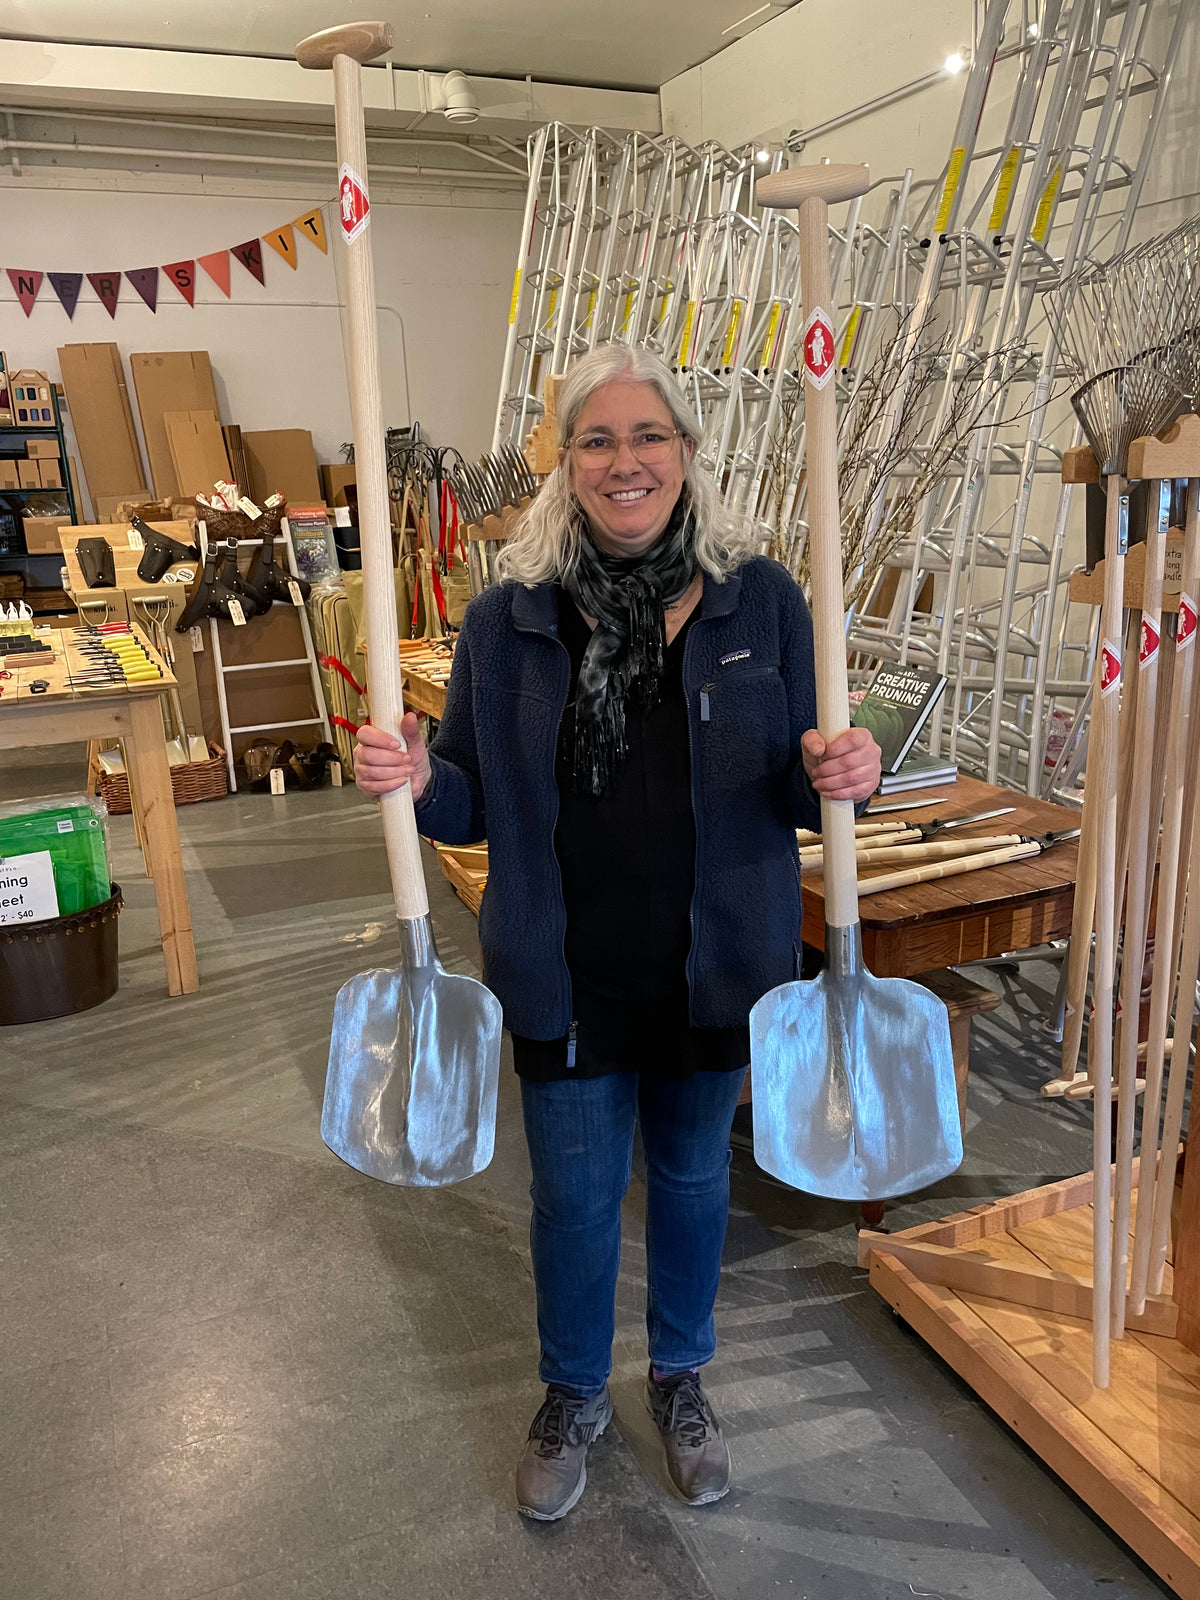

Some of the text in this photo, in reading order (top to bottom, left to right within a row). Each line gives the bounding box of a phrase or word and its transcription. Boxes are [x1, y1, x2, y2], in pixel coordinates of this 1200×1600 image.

[242, 217, 319, 268] KIT
[1167, 560, 1180, 574] long
[721, 653, 750, 665] patagonia
[877, 672, 931, 694] CREATIVE
[870, 683, 923, 706] PRUNING
[0, 893, 24, 908] eet
[18, 909, 34, 920] $40
